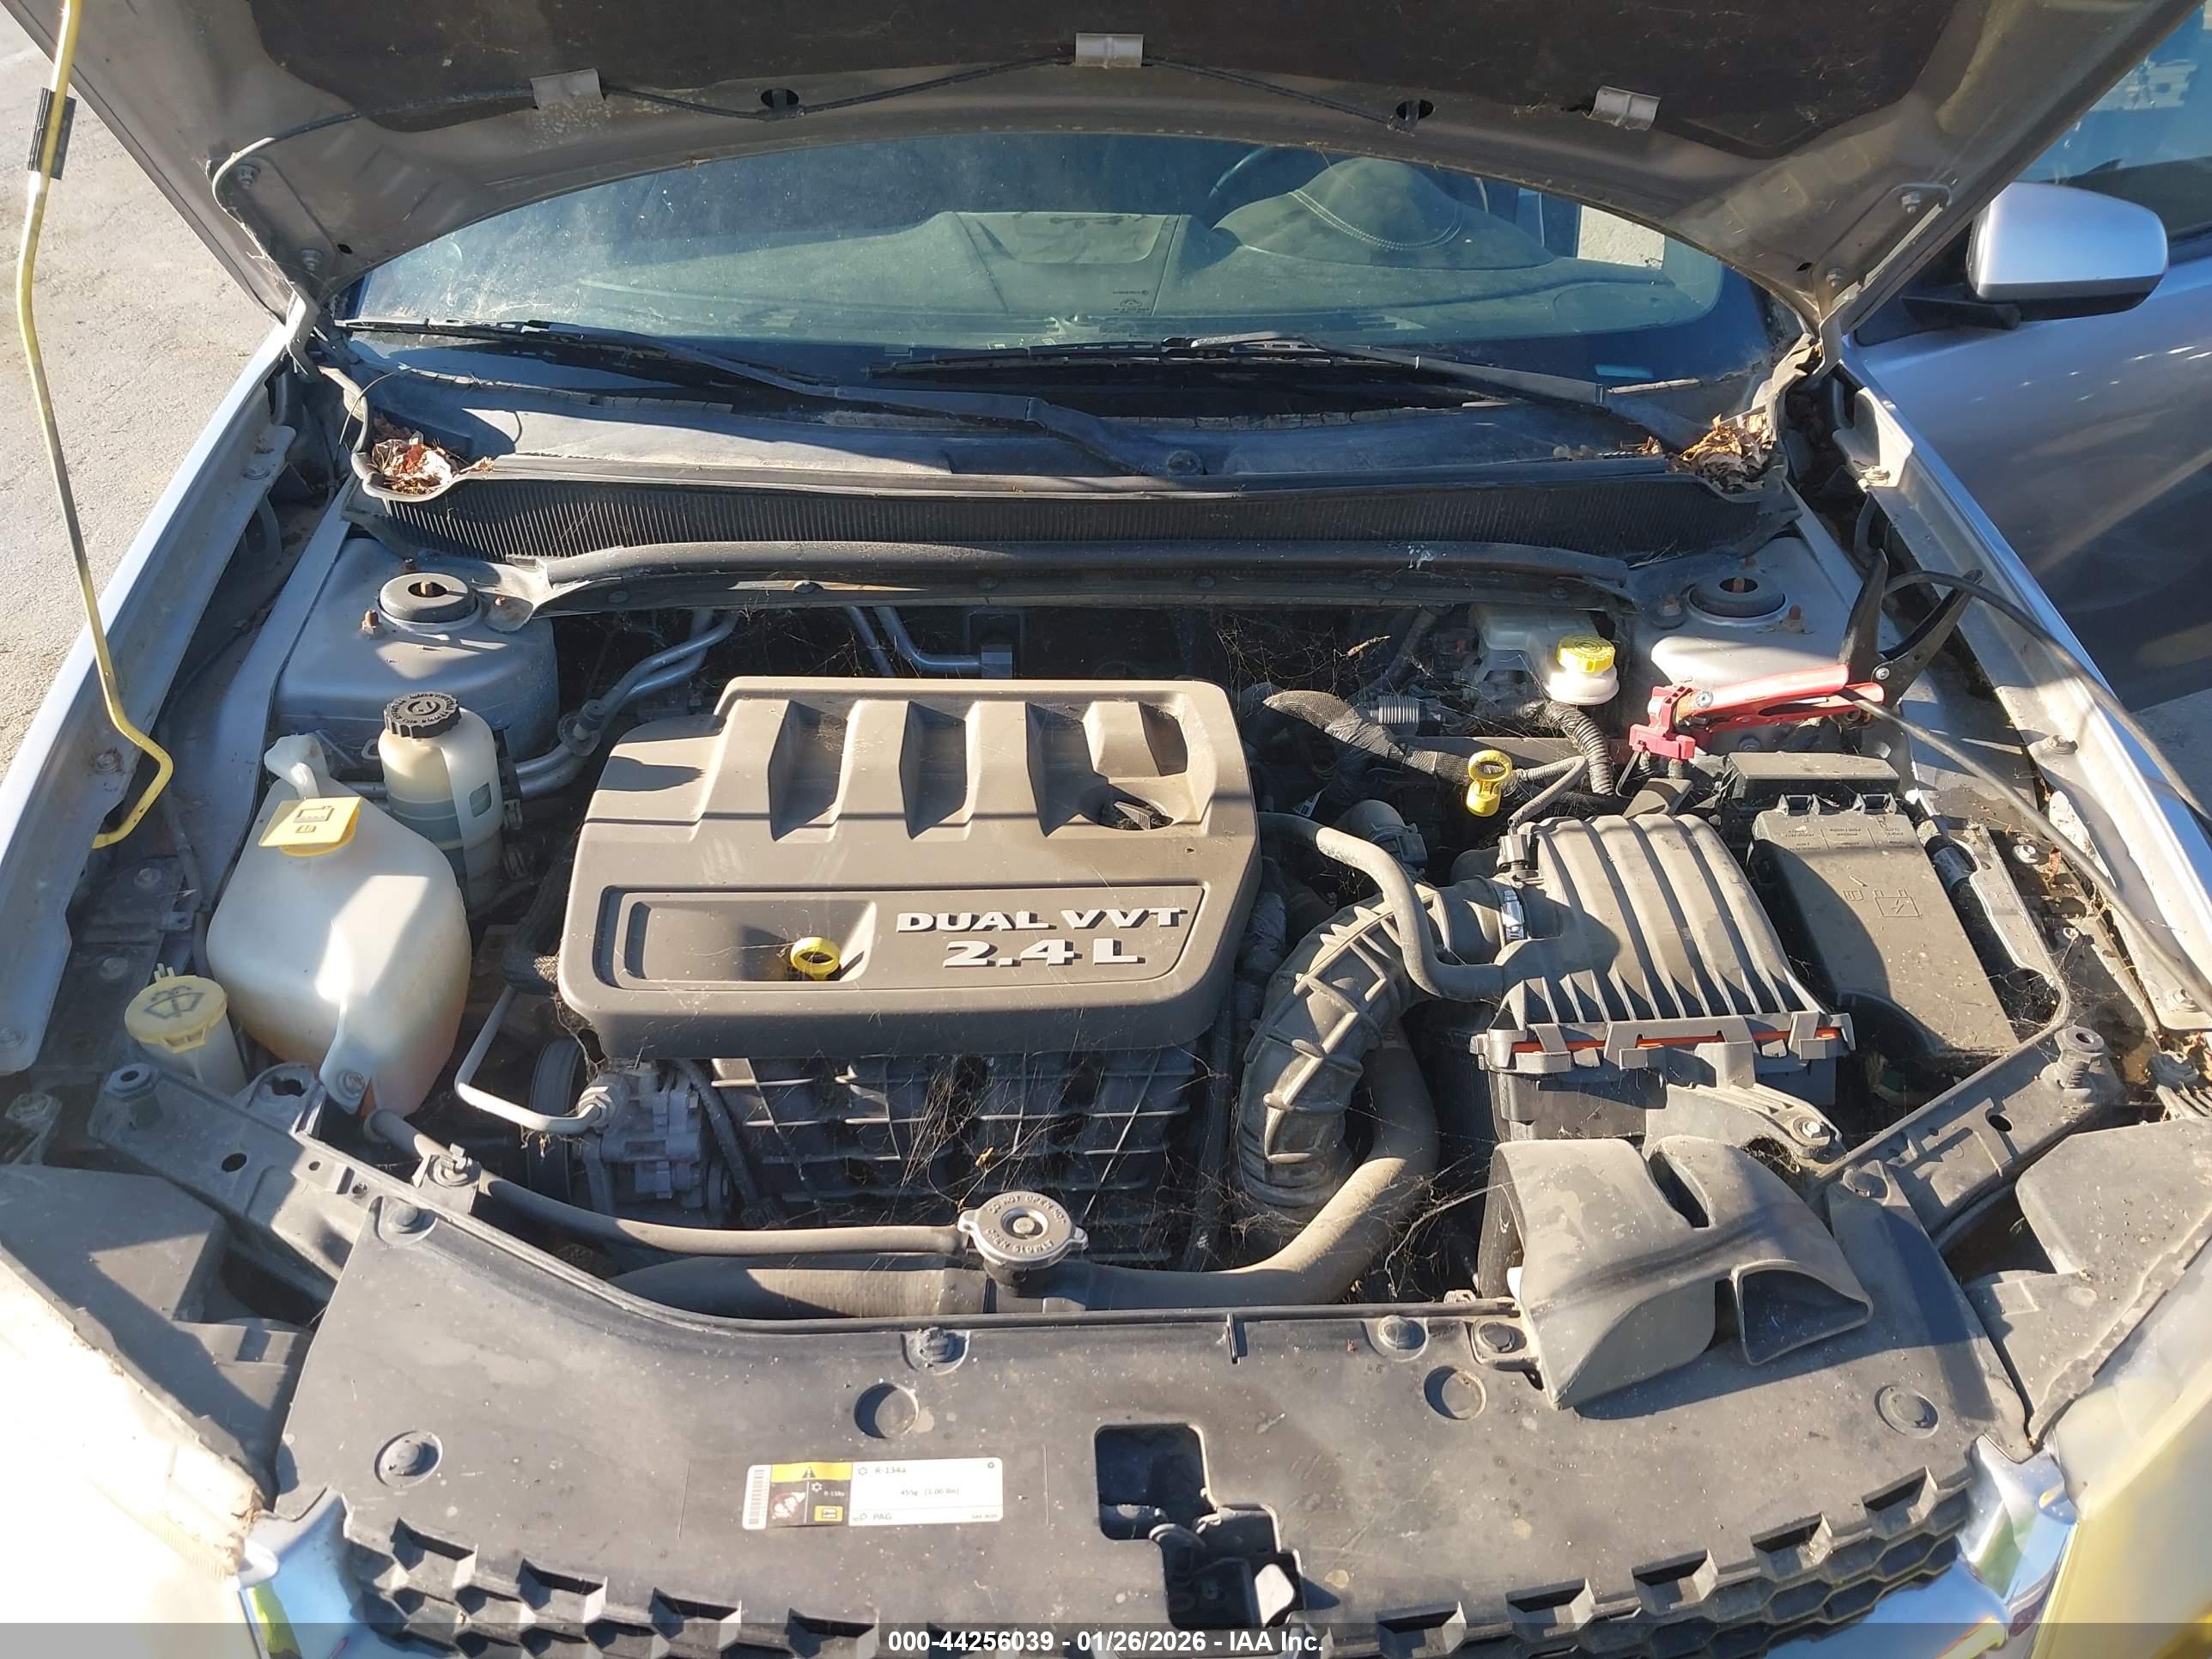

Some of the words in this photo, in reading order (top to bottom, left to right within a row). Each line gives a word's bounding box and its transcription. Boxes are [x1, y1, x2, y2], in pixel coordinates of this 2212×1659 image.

[896, 910, 1051, 933] DUAL
[1060, 907, 1187, 929] VVT
[988, 1203, 1001, 1215] DO
[1002, 1194, 1021, 1204] NOT
[1024, 1194, 1053, 1209] OPEN
[985, 1228, 1012, 1249] OPEN
[1012, 1238, 1055, 1255] SLOWLY
[874, 1467, 907, 1475] R-134a
